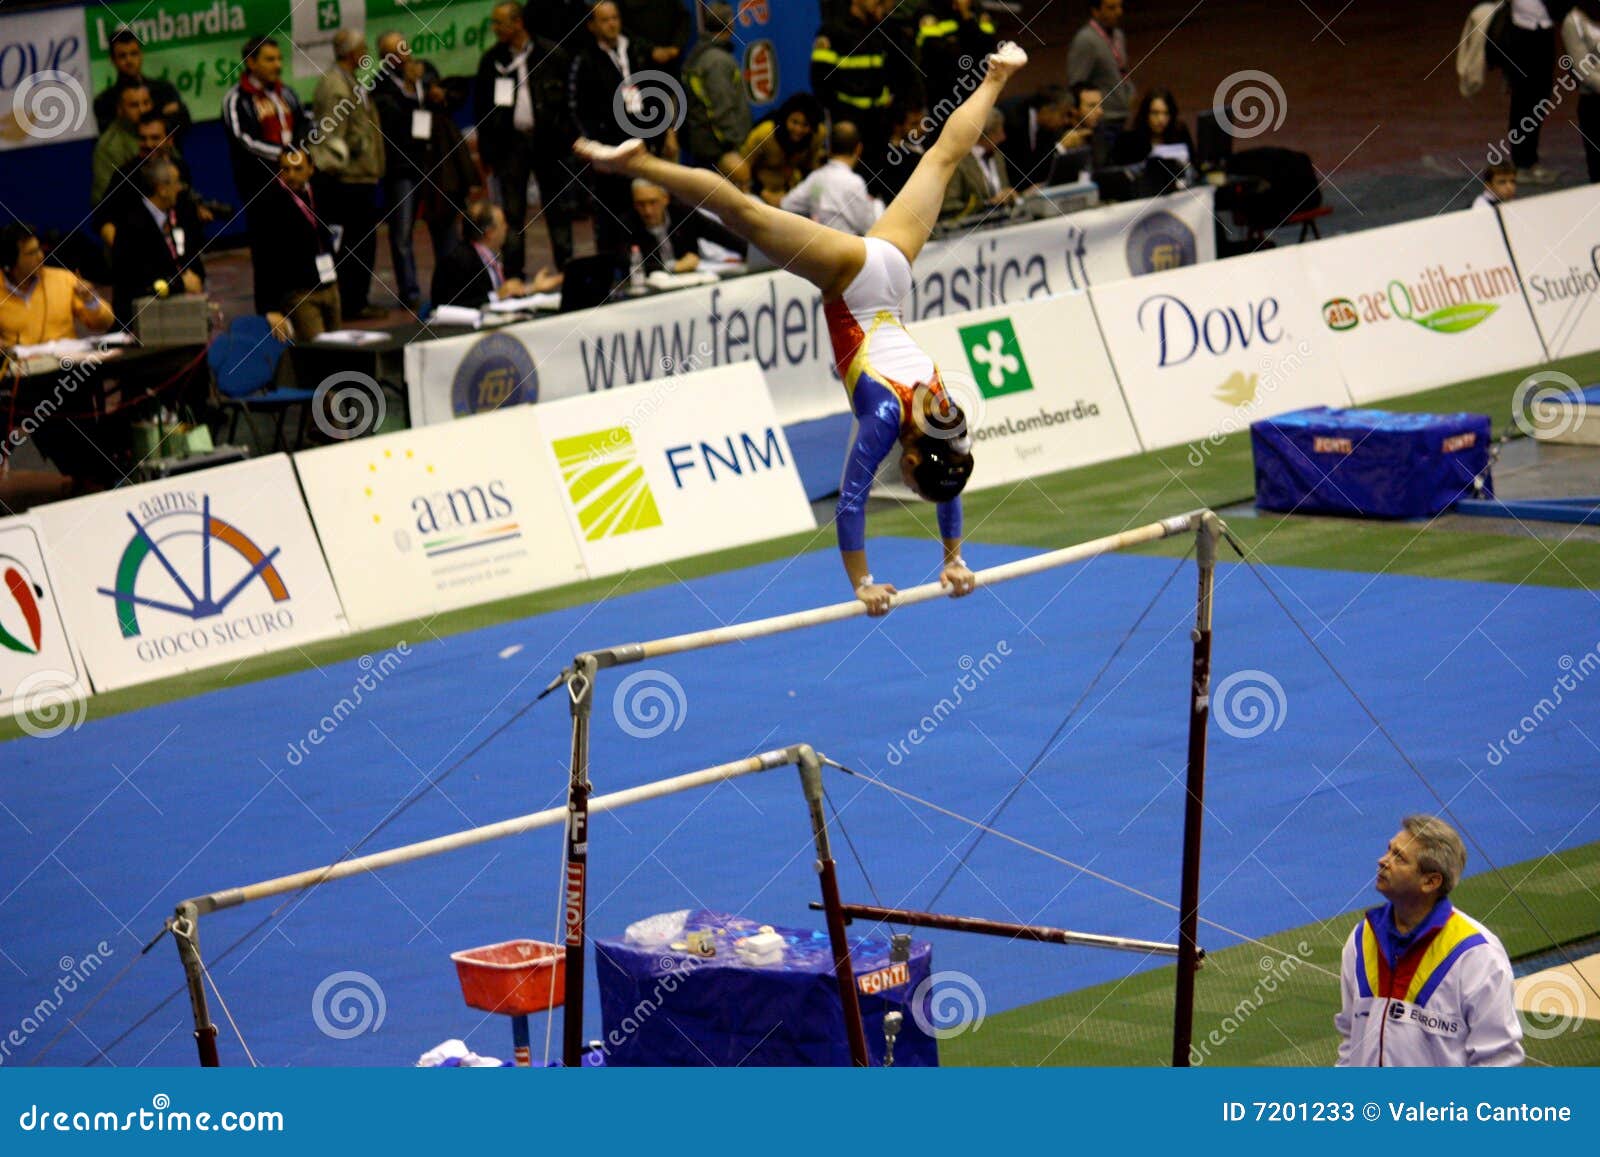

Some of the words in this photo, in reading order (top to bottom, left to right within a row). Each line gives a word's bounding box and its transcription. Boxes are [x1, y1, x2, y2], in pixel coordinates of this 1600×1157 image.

[1138, 294, 1284, 367] Dove
[664, 427, 785, 488] FNM
[137, 488, 198, 521] aams
[136, 624, 210, 663] GIOCO
[211, 607, 295, 648] SICURO
[860, 963, 910, 993] FONTI
